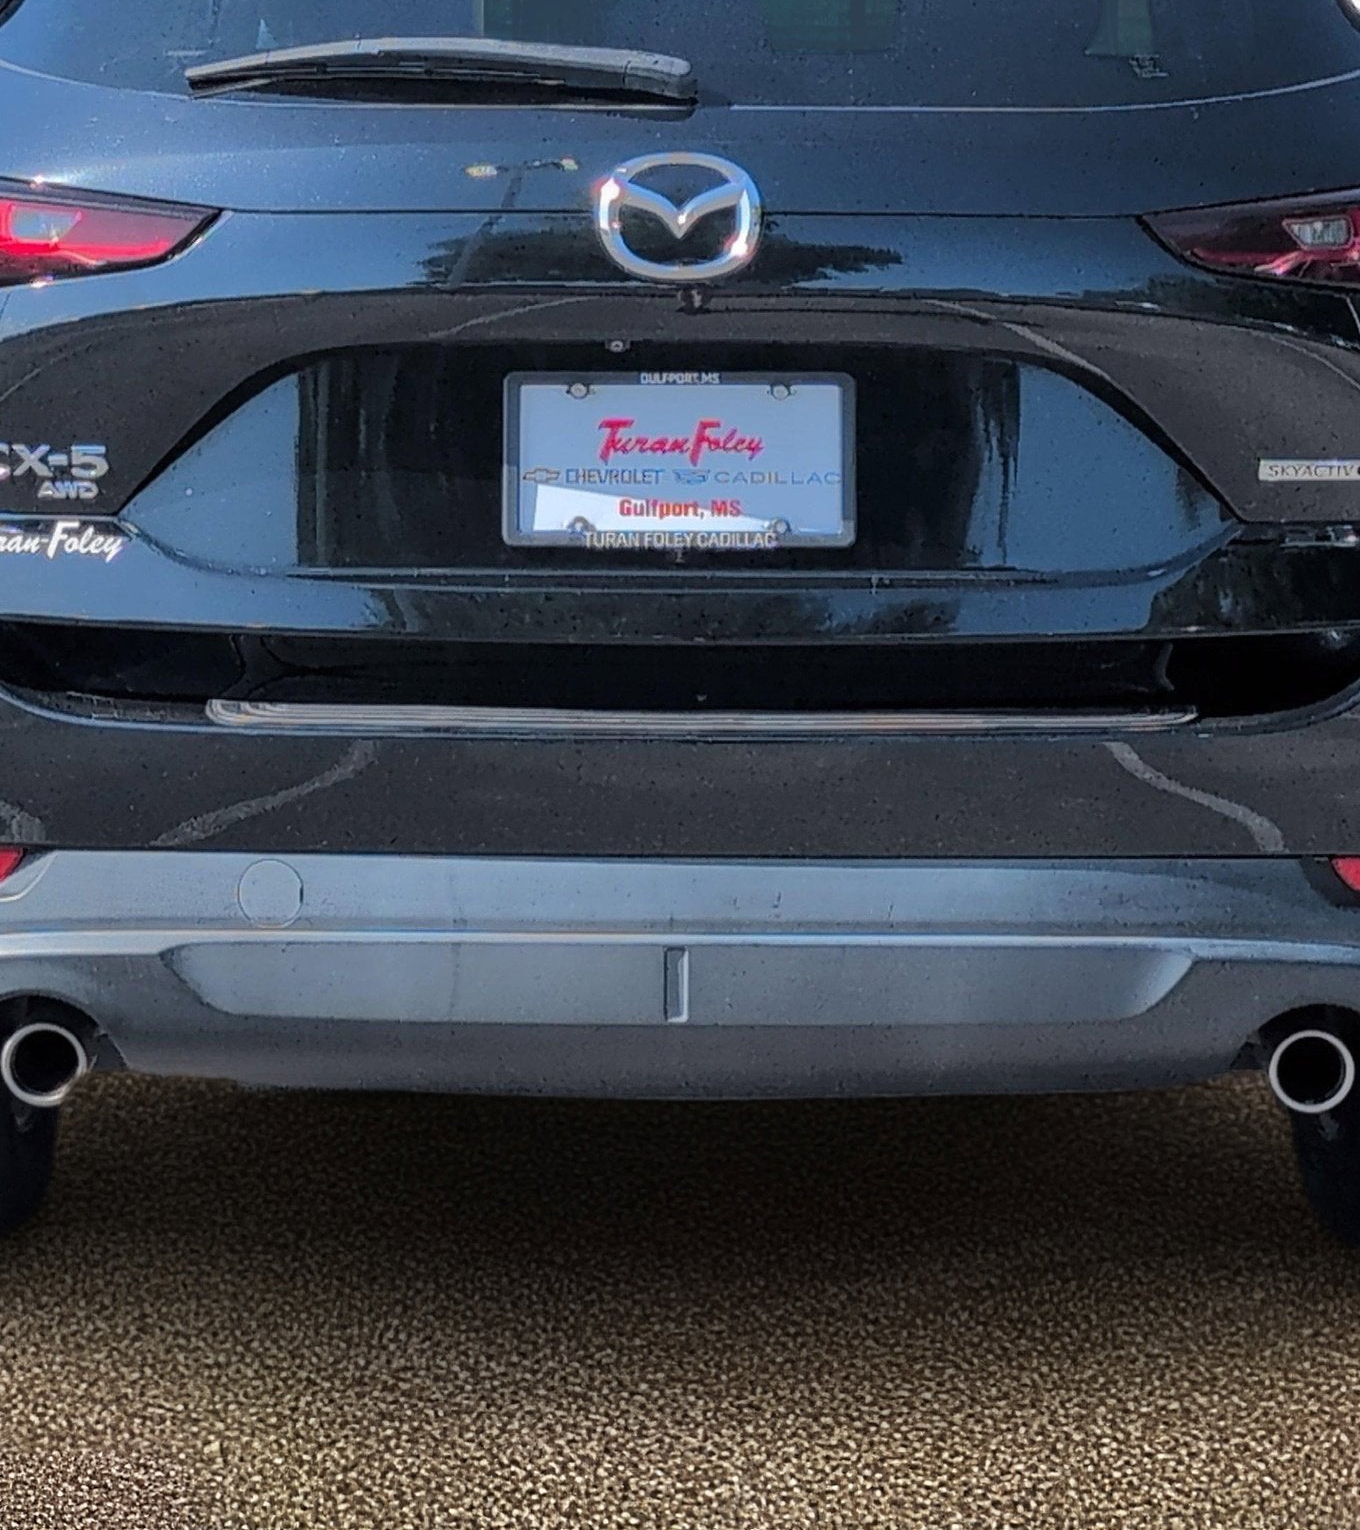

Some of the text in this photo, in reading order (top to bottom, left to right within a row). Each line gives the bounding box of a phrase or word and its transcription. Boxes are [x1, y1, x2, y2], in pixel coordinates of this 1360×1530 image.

[565, 468, 843, 485] CHEVROLET CADILLAC
[37, 480, 99, 500] AWD
[618, 498, 742, 520] Gulfport, MS
[584, 532, 779, 551] TURAN FOLEY CADILLAC
